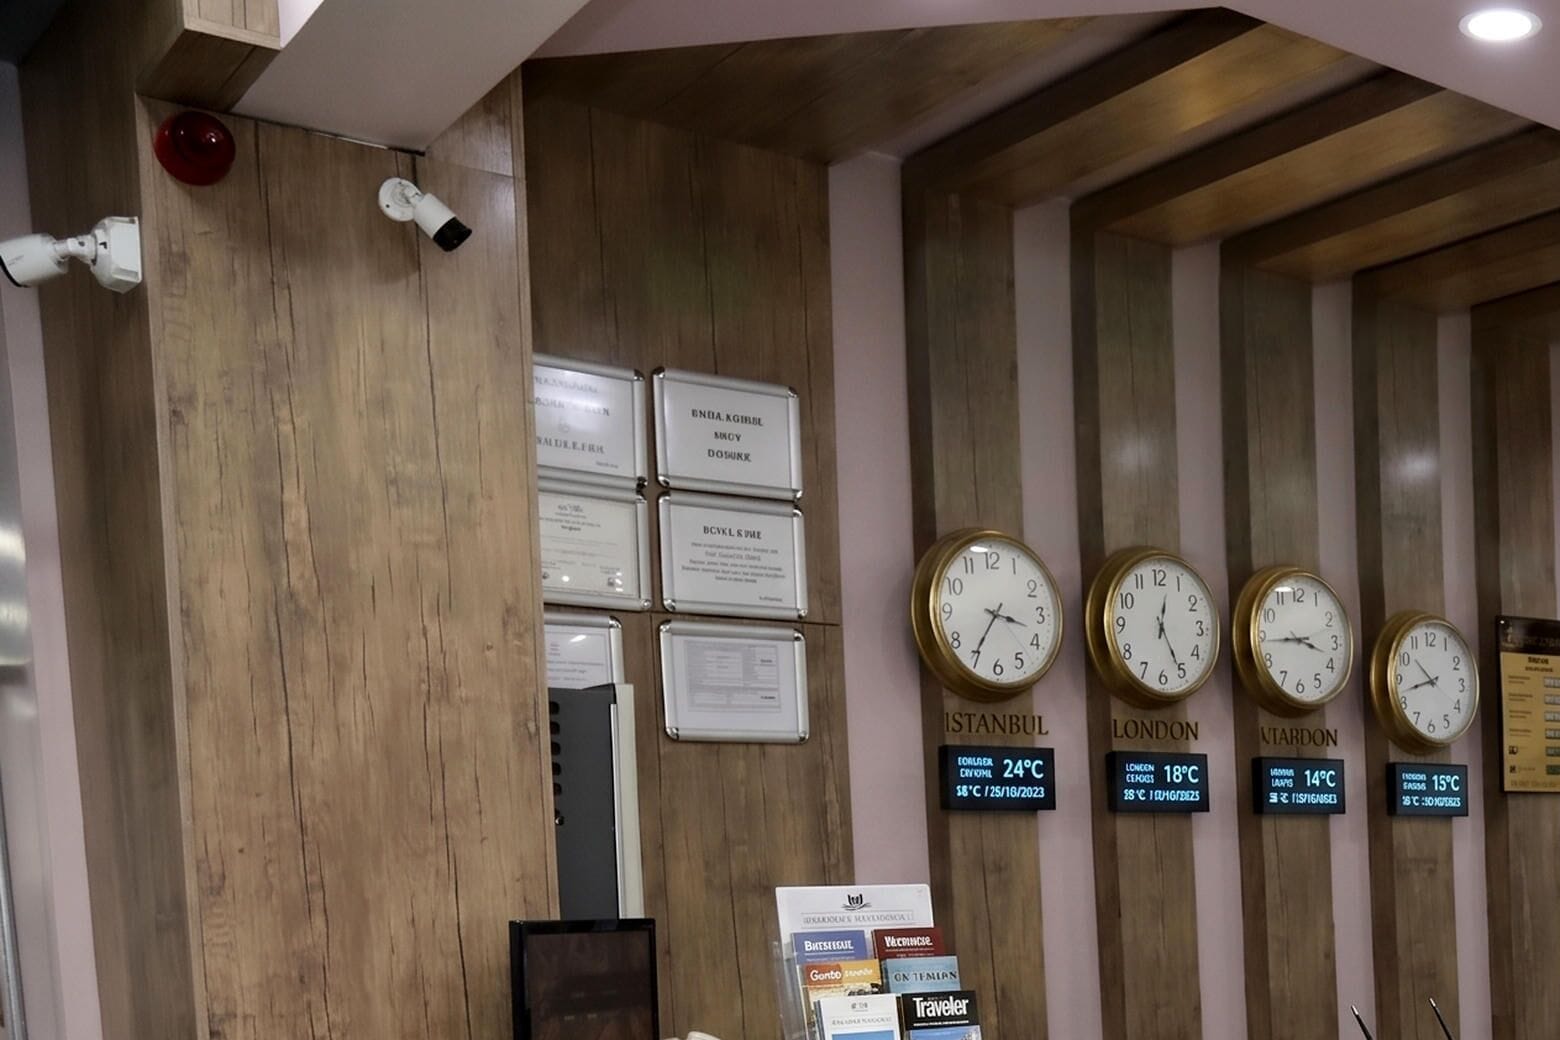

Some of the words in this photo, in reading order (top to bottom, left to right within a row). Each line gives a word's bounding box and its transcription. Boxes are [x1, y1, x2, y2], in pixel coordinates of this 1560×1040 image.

[963, 556, 974, 574] 11
[984, 552, 1000, 570] 12
[1135, 574, 1143, 589] 11
[1152, 569, 1166, 586] 12
[947, 577, 963, 596] 10
[1027, 579, 1037, 598] 2
[1120, 592, 1134, 609] 10
[1188, 594, 1197, 611] 2
[1276, 591, 1284, 605] 11
[1292, 588, 1305, 603] 12
[942, 602, 952, 621] 9
[1036, 606, 1045, 624] 3
[1264, 608, 1276, 624] 10
[1325, 611, 1333, 627] 2
[1116, 616, 1125, 634] 9
[1196, 620, 1204, 637] 3
[951, 631, 961, 649] 8
[1030, 633, 1040, 650] 4
[1331, 635, 1338, 651] 3
[1411, 636, 1418, 650] 11
[1425, 632, 1436, 647] 12
[971, 650, 980, 669] 7
[1123, 643, 1132, 660] 8
[1191, 644, 1199, 660] 4
[993, 659, 1004, 675] 6
[1014, 652, 1024, 670] 5
[1326, 657, 1335, 673] 4
[1453, 656, 1460, 671] 2
[1140, 661, 1148, 680] 7
[1158, 669, 1168, 685] 6
[1177, 662, 1186, 679] 5
[1280, 670, 1288, 687] 7
[1296, 679, 1305, 694] 6
[1314, 673, 1322, 689] 5
[1458, 678, 1465, 693] 3
[1453, 699, 1460, 714] 4
[945, 712, 1049, 736] ISTANBUL
[1413, 711, 1421, 725] 7
[1427, 718, 1436, 733] 6
[1443, 714, 1450, 729] 5
[1113, 719, 1198, 740] LONDON
[1003, 759, 1044, 779] 24°C
[1164, 764, 1199, 783] 18°C
[1304, 769, 1336, 787] 14°C
[1432, 774, 1460, 791] 15°C
[912, 996, 969, 1018] Traveler
